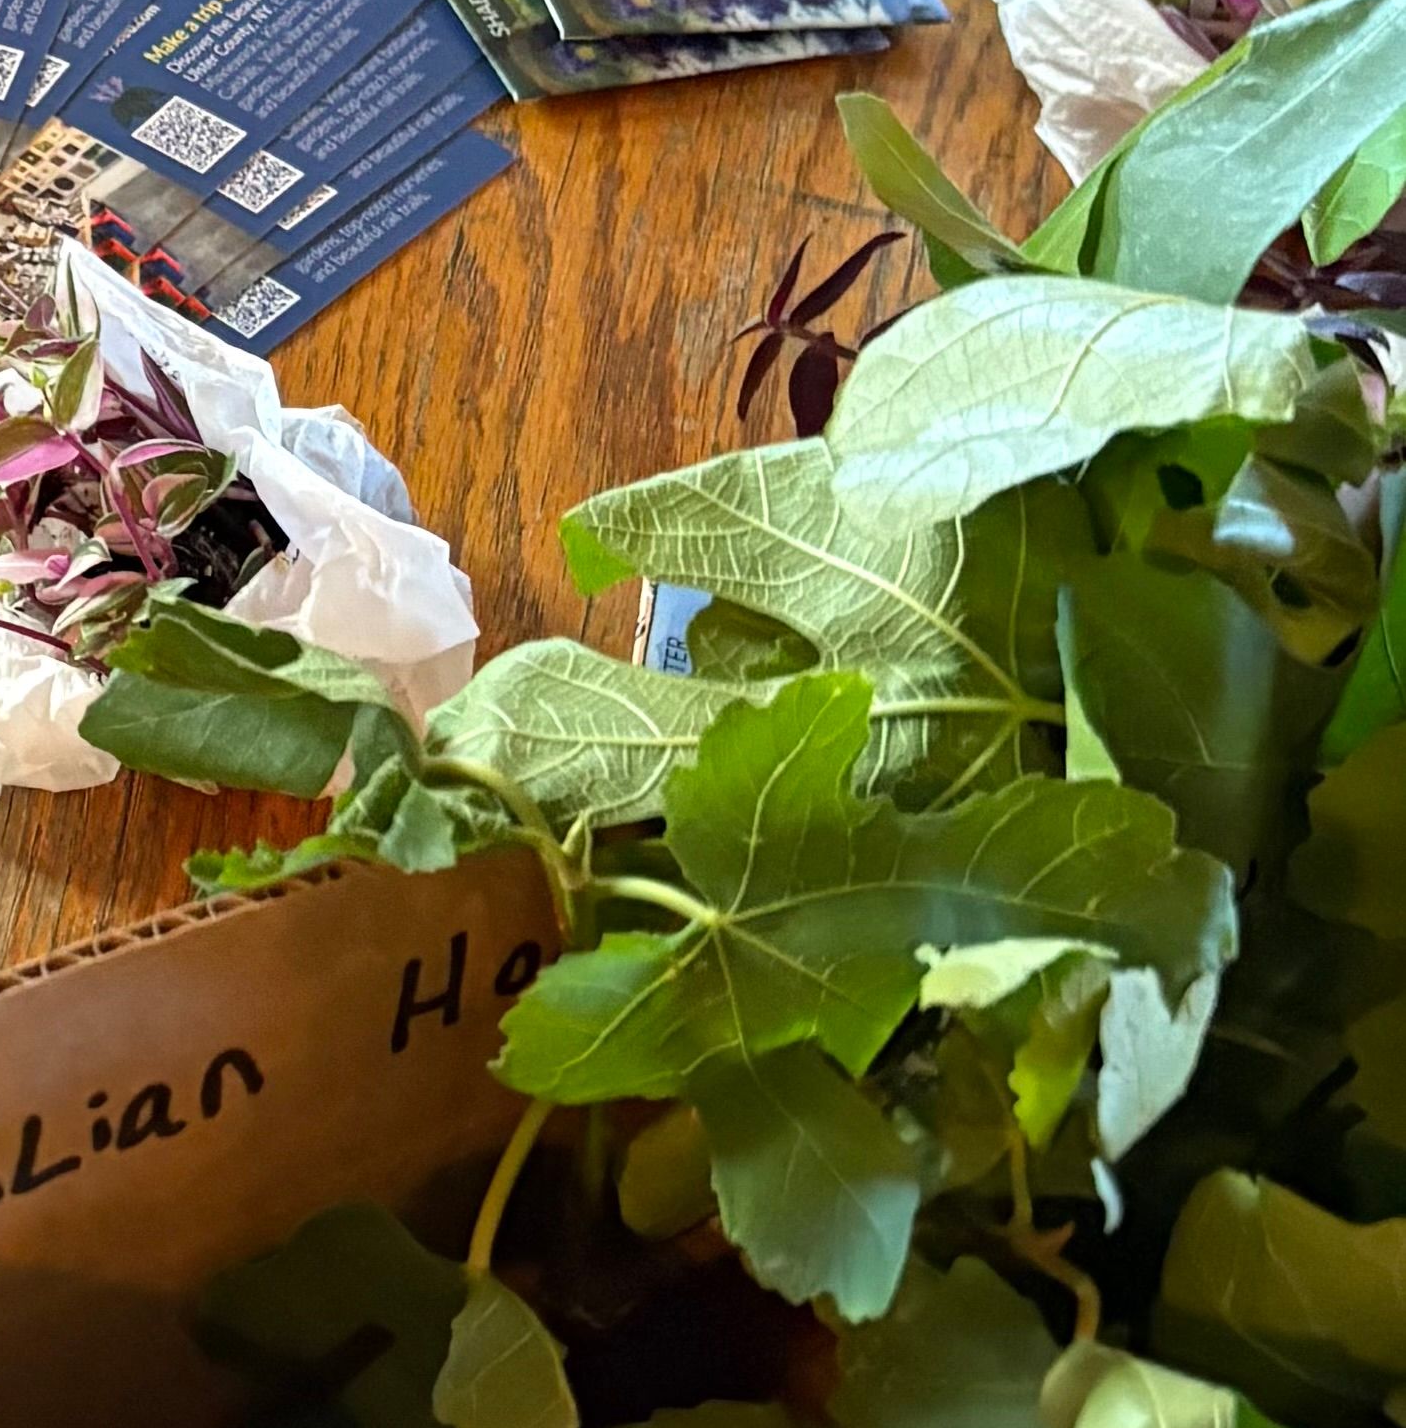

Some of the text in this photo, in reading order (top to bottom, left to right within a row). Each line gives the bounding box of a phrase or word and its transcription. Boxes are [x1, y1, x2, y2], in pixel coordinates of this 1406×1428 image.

[142, 29, 190, 65] Make
[184, 17, 200, 32] a
[165, 33, 214, 75] Discover
[210, 16, 233, 37] the
[182, 52, 219, 83] Ulster
[213, 19, 260, 57] County,
